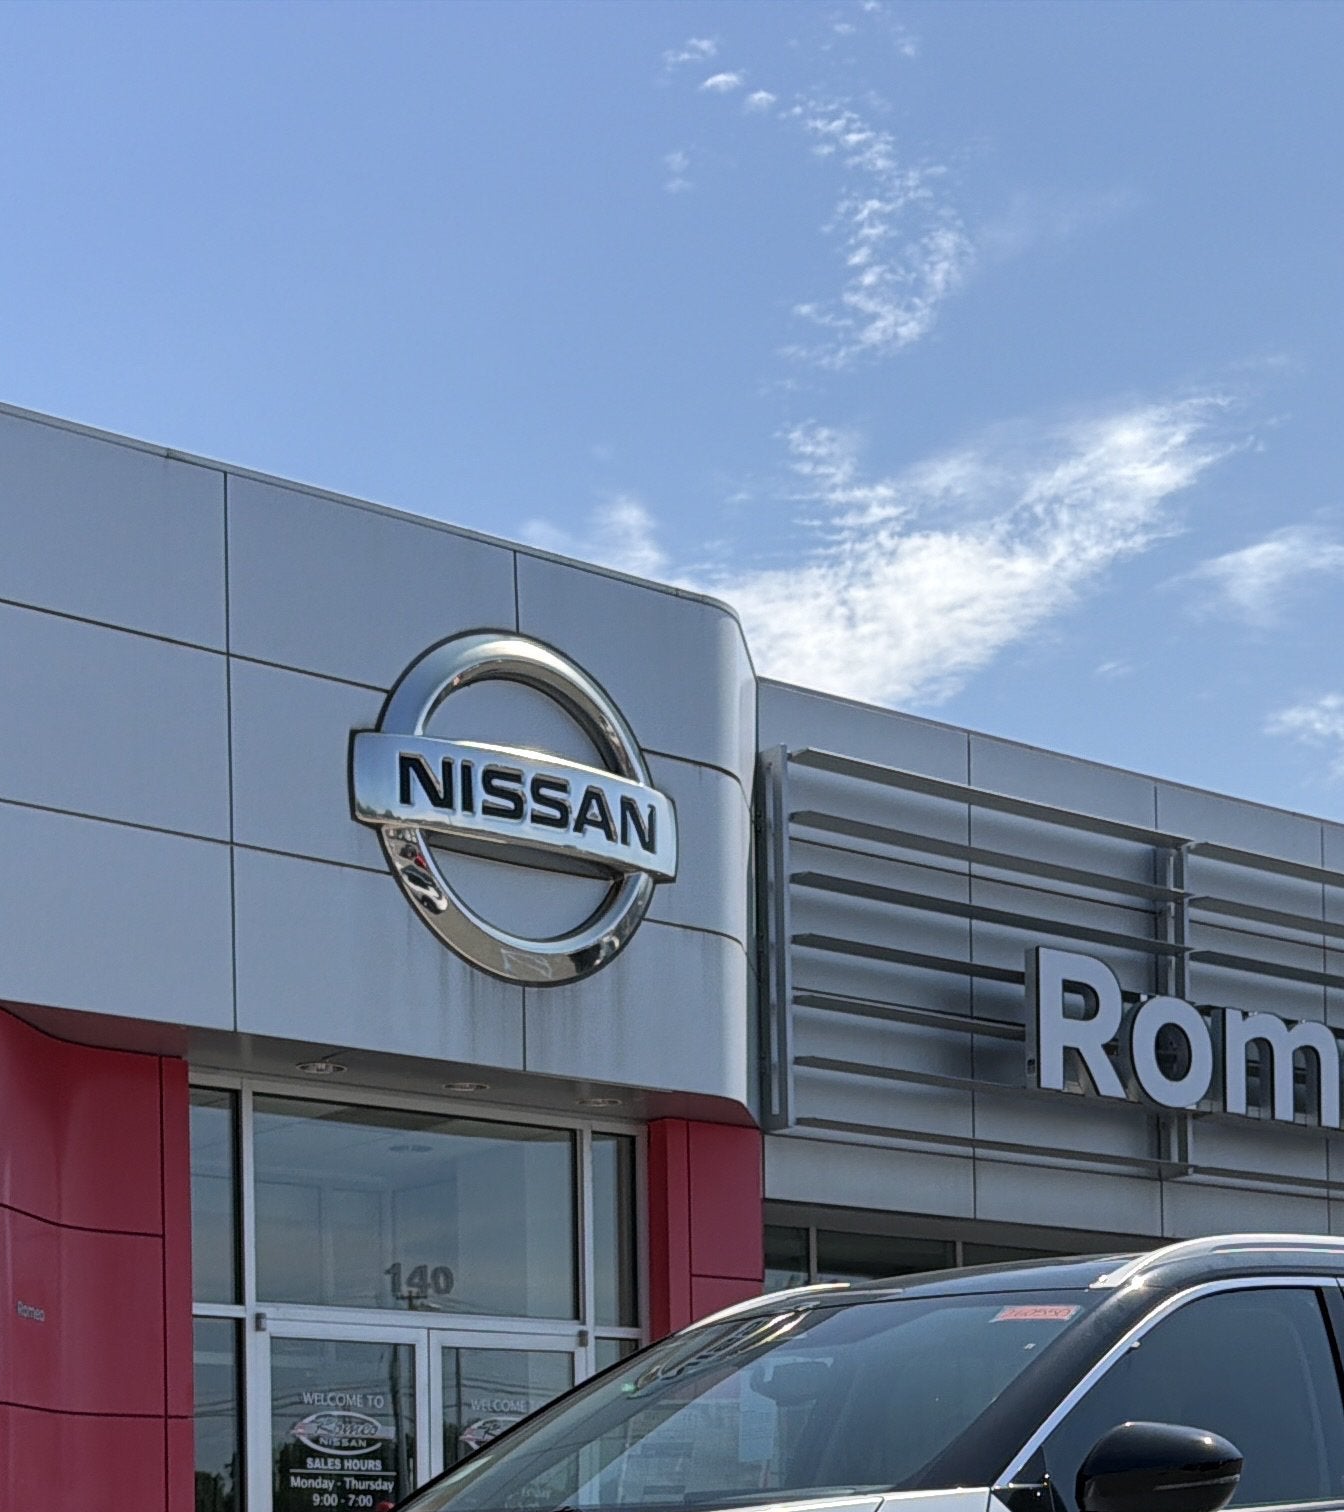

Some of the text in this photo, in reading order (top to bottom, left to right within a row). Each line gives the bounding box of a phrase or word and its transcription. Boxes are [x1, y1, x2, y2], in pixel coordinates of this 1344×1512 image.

[398, 752, 657, 855] NISSAN
[384, 1262, 455, 1300] 140
[302, 1392, 385, 1409] WELCOME TO
[471, 1399, 526, 1414] WELCOME
[318, 1437, 367, 1448] NISSAN
[306, 1457, 382, 1471] SALES HOURS
[290, 1476, 335, 1491] Monday
[343, 1477, 395, 1492] Thursday
[312, 1493, 338, 1507] 9:00
[348, 1494, 374, 1507] 7:00
